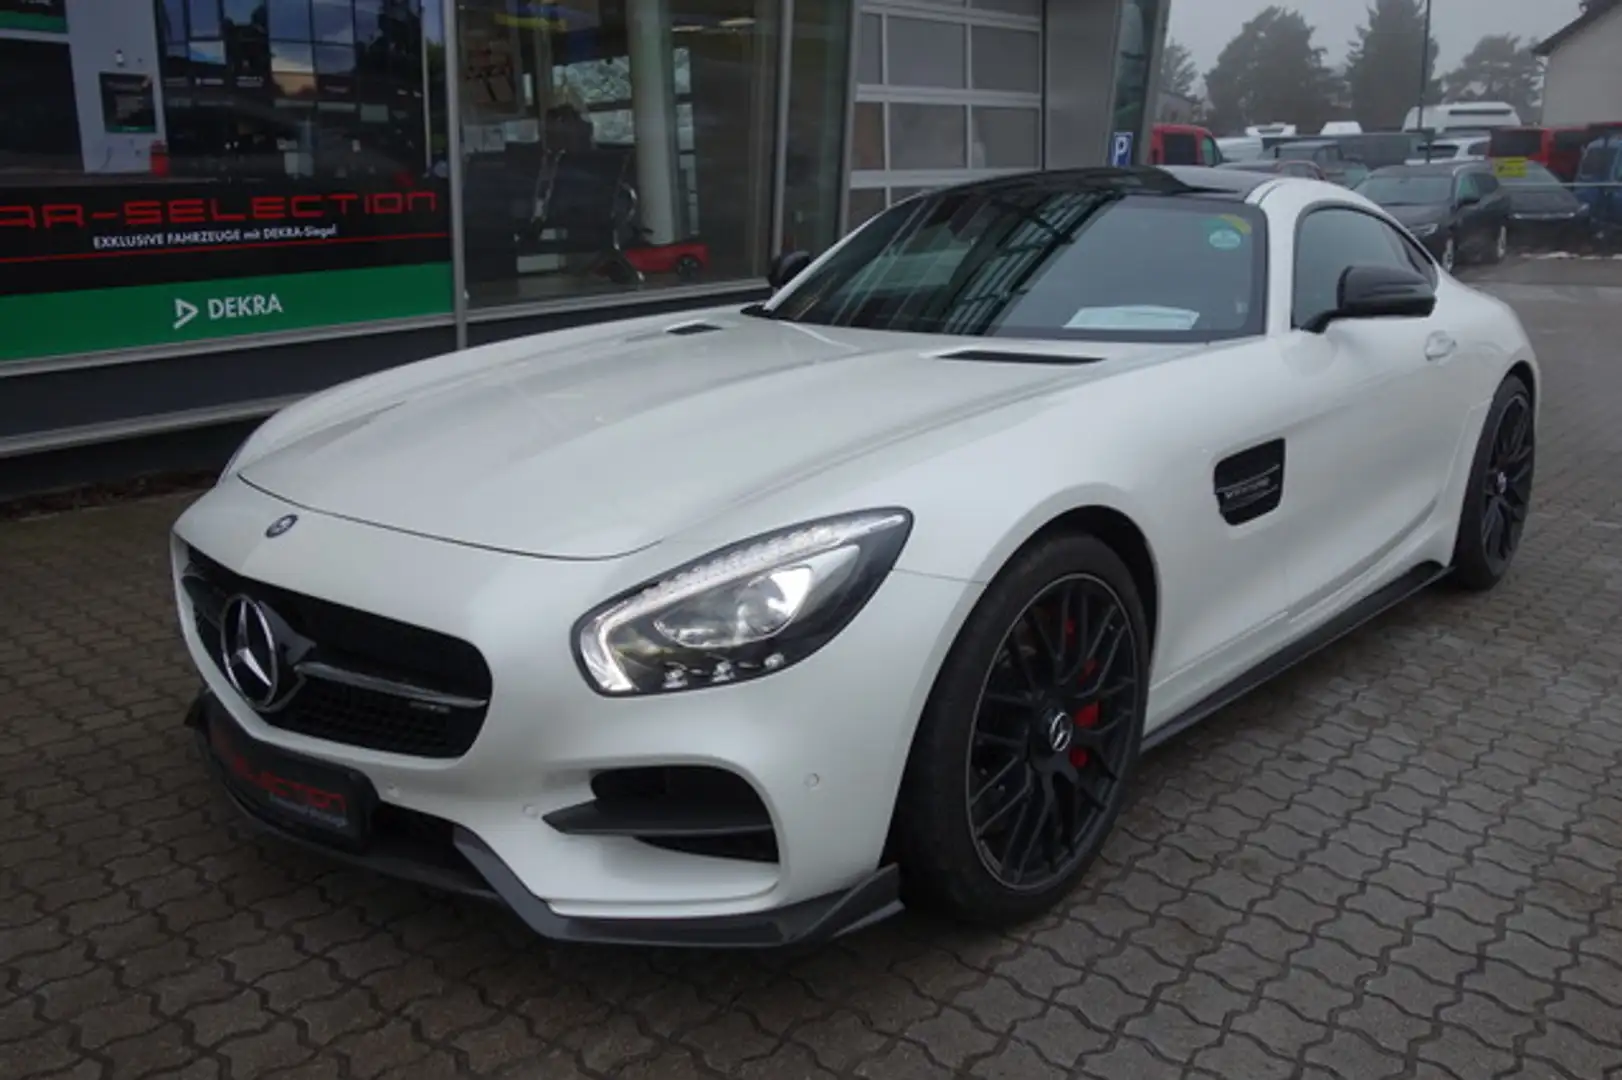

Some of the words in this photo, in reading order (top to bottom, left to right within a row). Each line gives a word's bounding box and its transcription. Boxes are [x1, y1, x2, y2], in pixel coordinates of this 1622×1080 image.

[1112, 136, 1128, 168] P
[93, 232, 164, 249] EXKLUSIVE
[167, 228, 241, 245] FAHRZEUGE
[243, 228, 260, 240] mit
[207, 292, 284, 320] DEKRA
